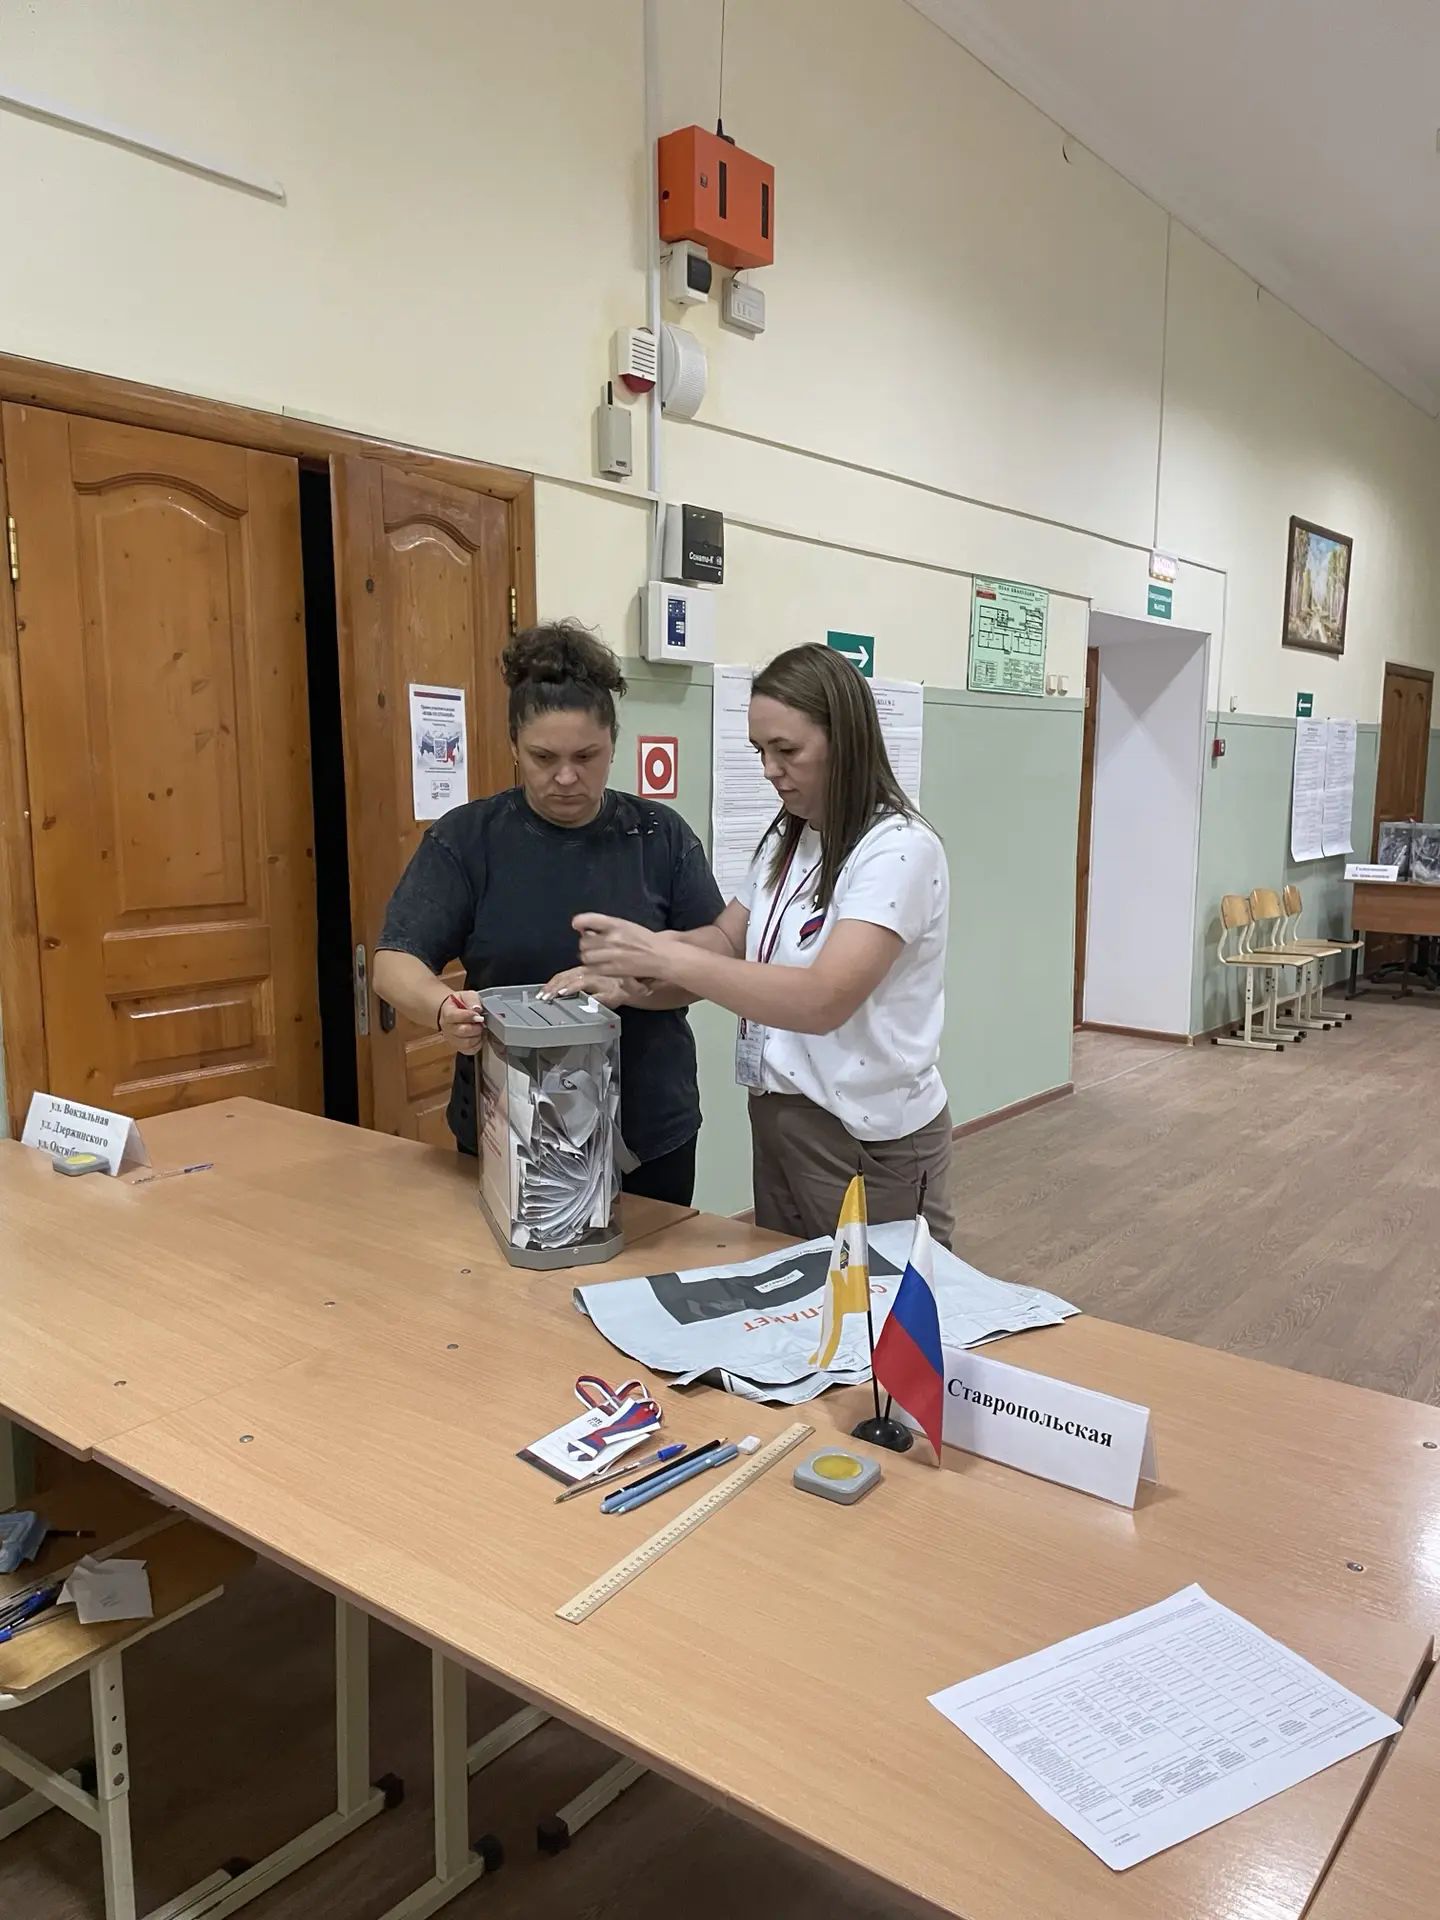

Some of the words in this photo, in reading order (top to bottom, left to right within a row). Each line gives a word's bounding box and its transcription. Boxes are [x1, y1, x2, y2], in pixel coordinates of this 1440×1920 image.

[49, 1102, 62, 1112] ул.
[64, 1103, 109, 1126] Вокзальная
[37, 1139, 48, 1150] ул.
[40, 1120, 51, 1130] ул.
[52, 1121, 108, 1147] Дзержинского
[947, 1378, 1113, 1448] Ставропольская
